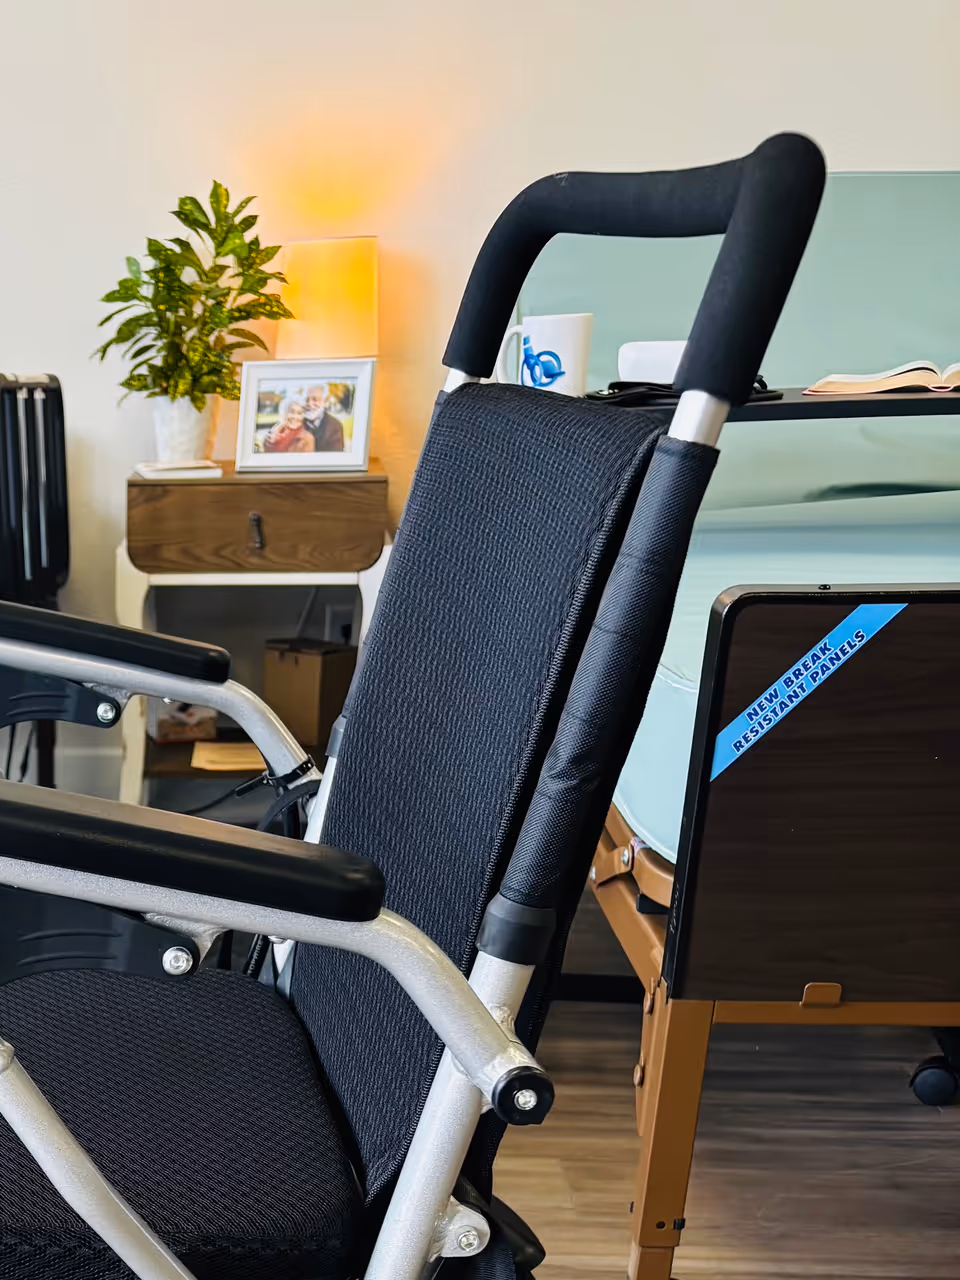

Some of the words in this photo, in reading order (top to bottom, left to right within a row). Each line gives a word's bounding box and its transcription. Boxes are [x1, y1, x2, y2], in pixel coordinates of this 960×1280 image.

[732, 682, 807, 753] RESISTANT
[809, 630, 866, 685] PANELS
[746, 688, 780, 722] NEW
[782, 641, 833, 690] BREAK
